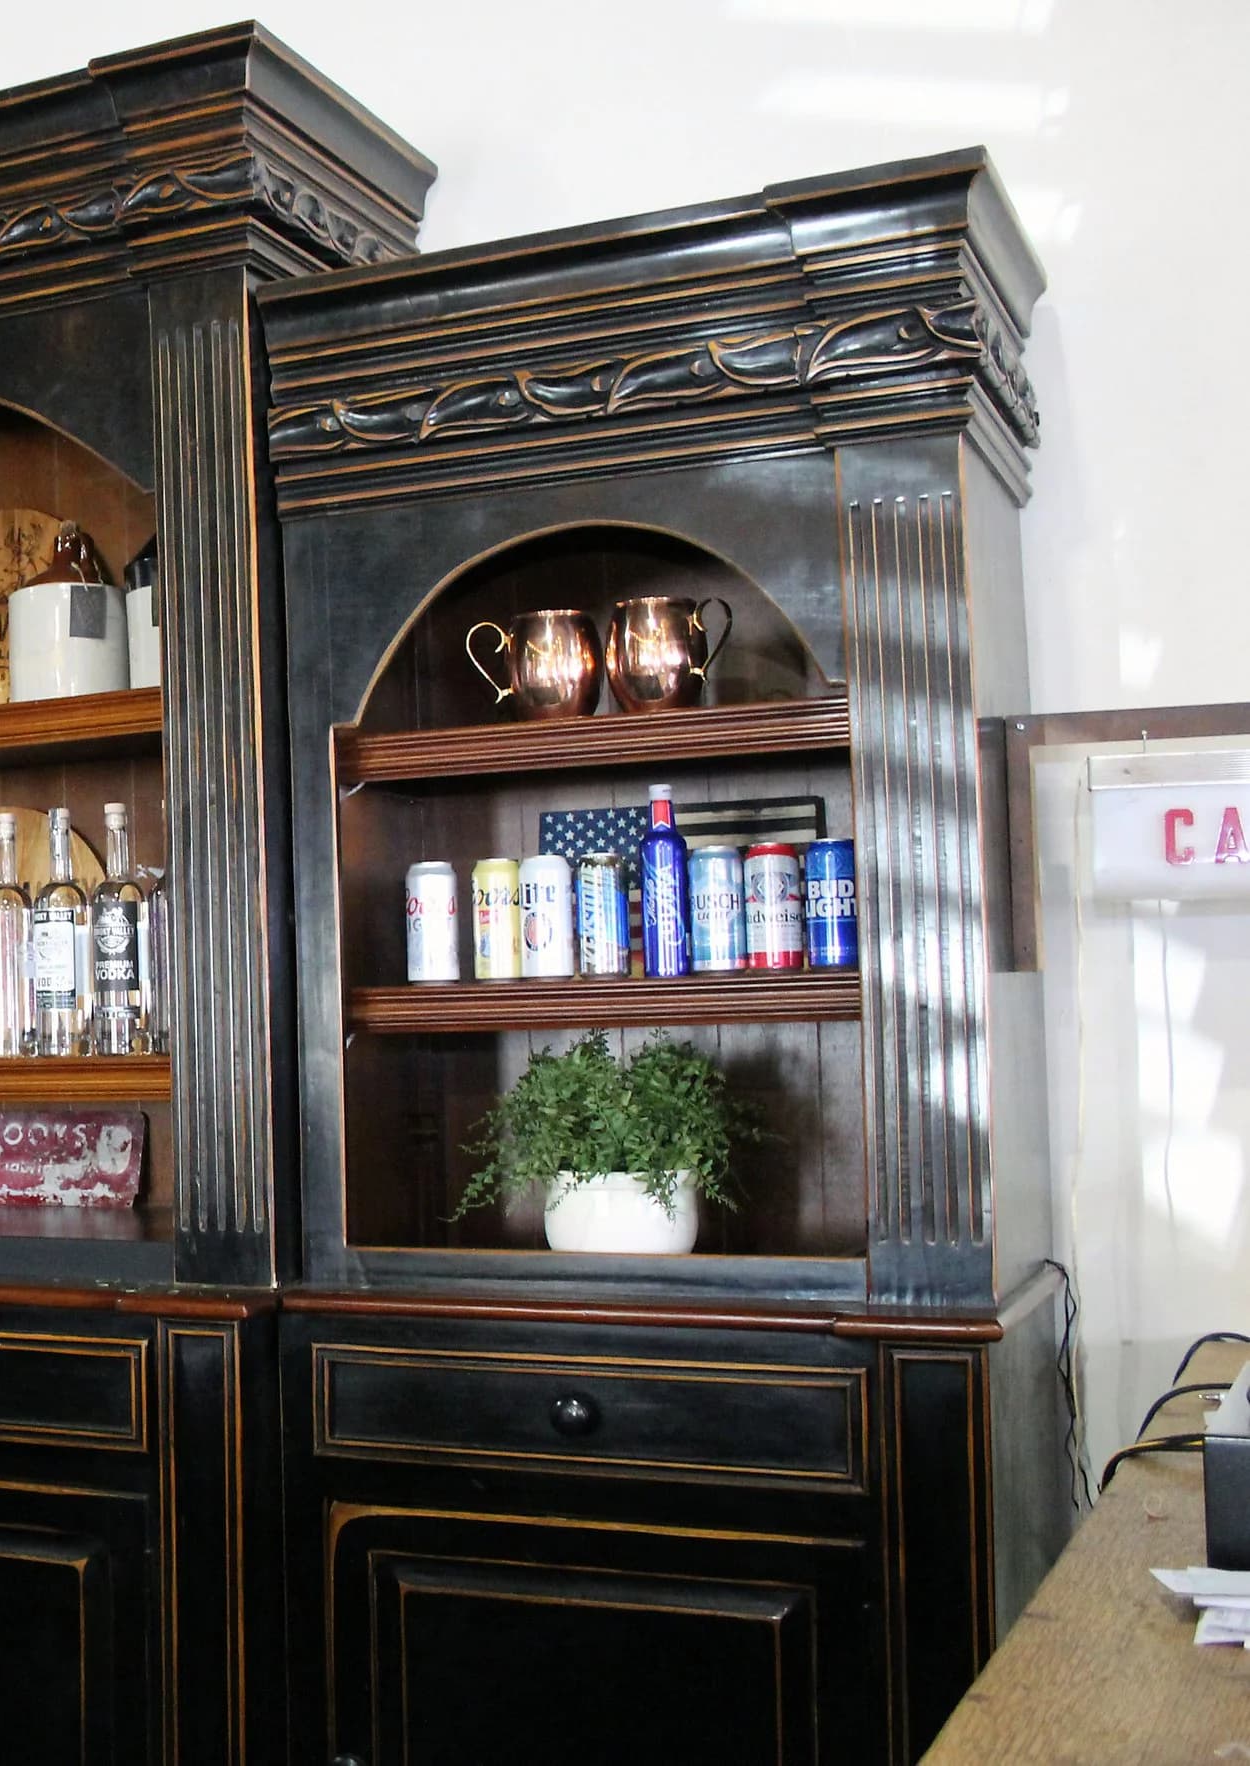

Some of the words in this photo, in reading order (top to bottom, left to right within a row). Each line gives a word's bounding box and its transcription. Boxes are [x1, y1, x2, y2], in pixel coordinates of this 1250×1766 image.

[808, 880, 854, 898] BUD
[95, 960, 133, 970] PREMIUM
[95, 969, 135, 980] VODKA
